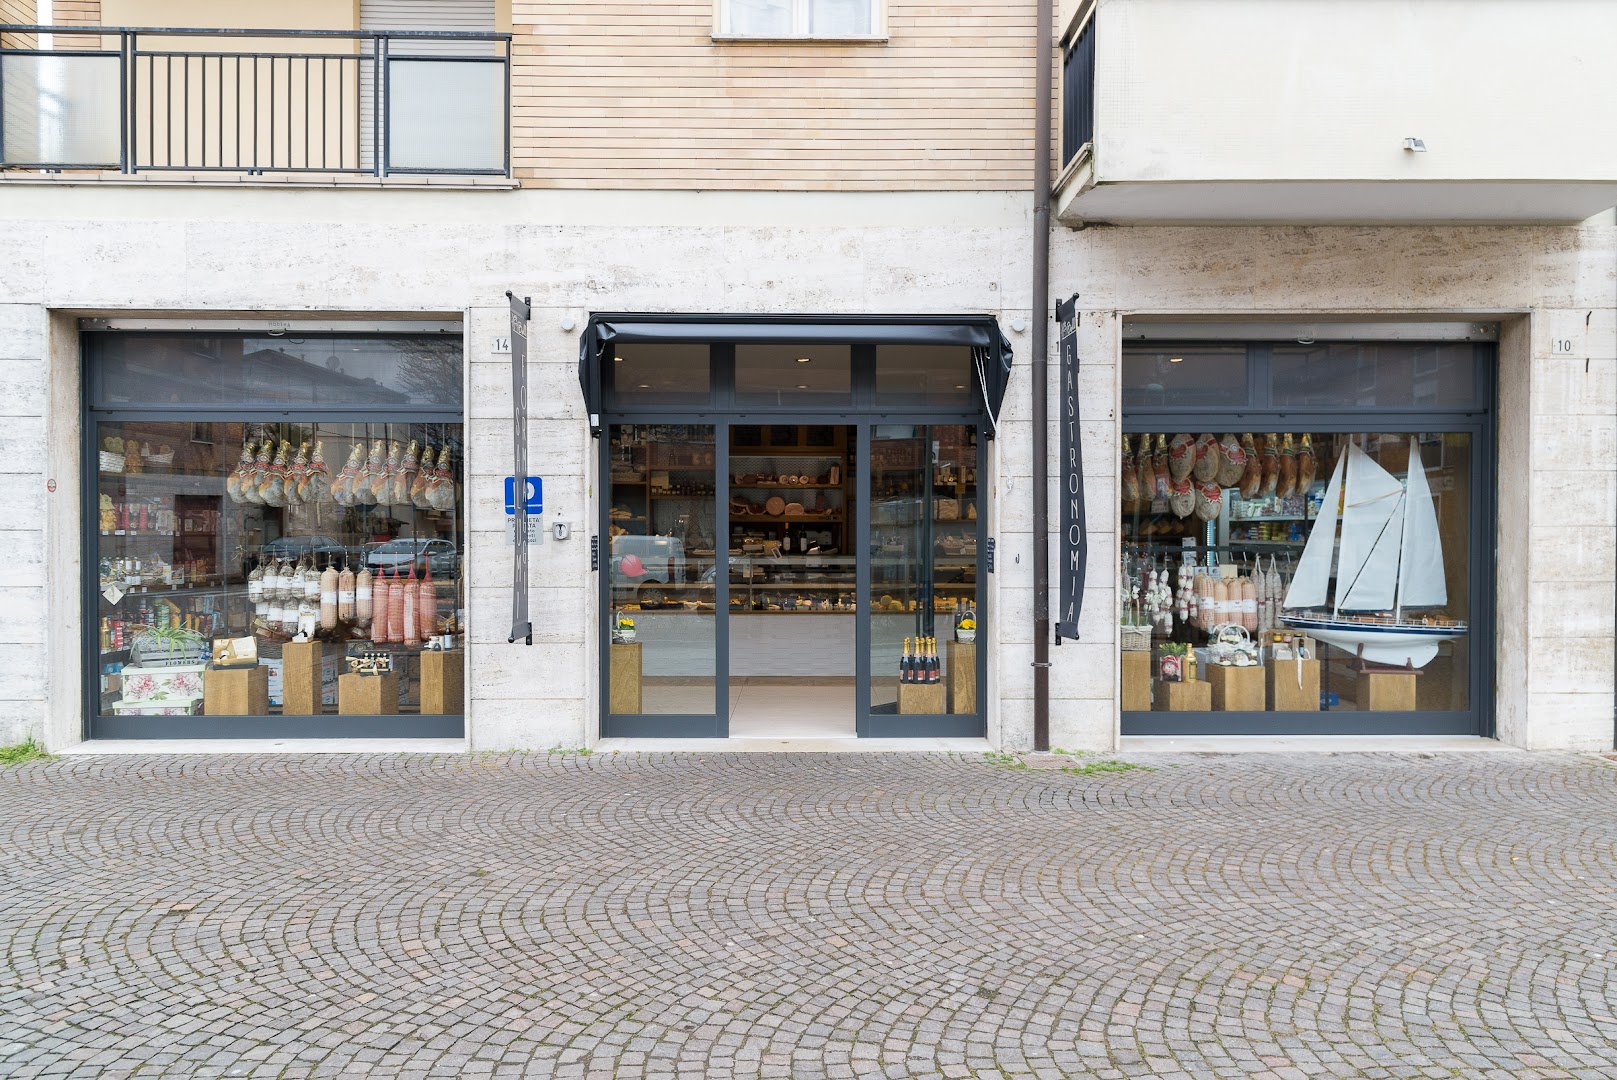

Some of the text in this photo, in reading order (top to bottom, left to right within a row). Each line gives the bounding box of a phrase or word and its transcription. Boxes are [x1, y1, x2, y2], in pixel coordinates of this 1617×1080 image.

[496, 338, 509, 351] 14
[1558, 340, 1571, 352] 10
[1066, 344, 1081, 622] GASTRONOMIA
